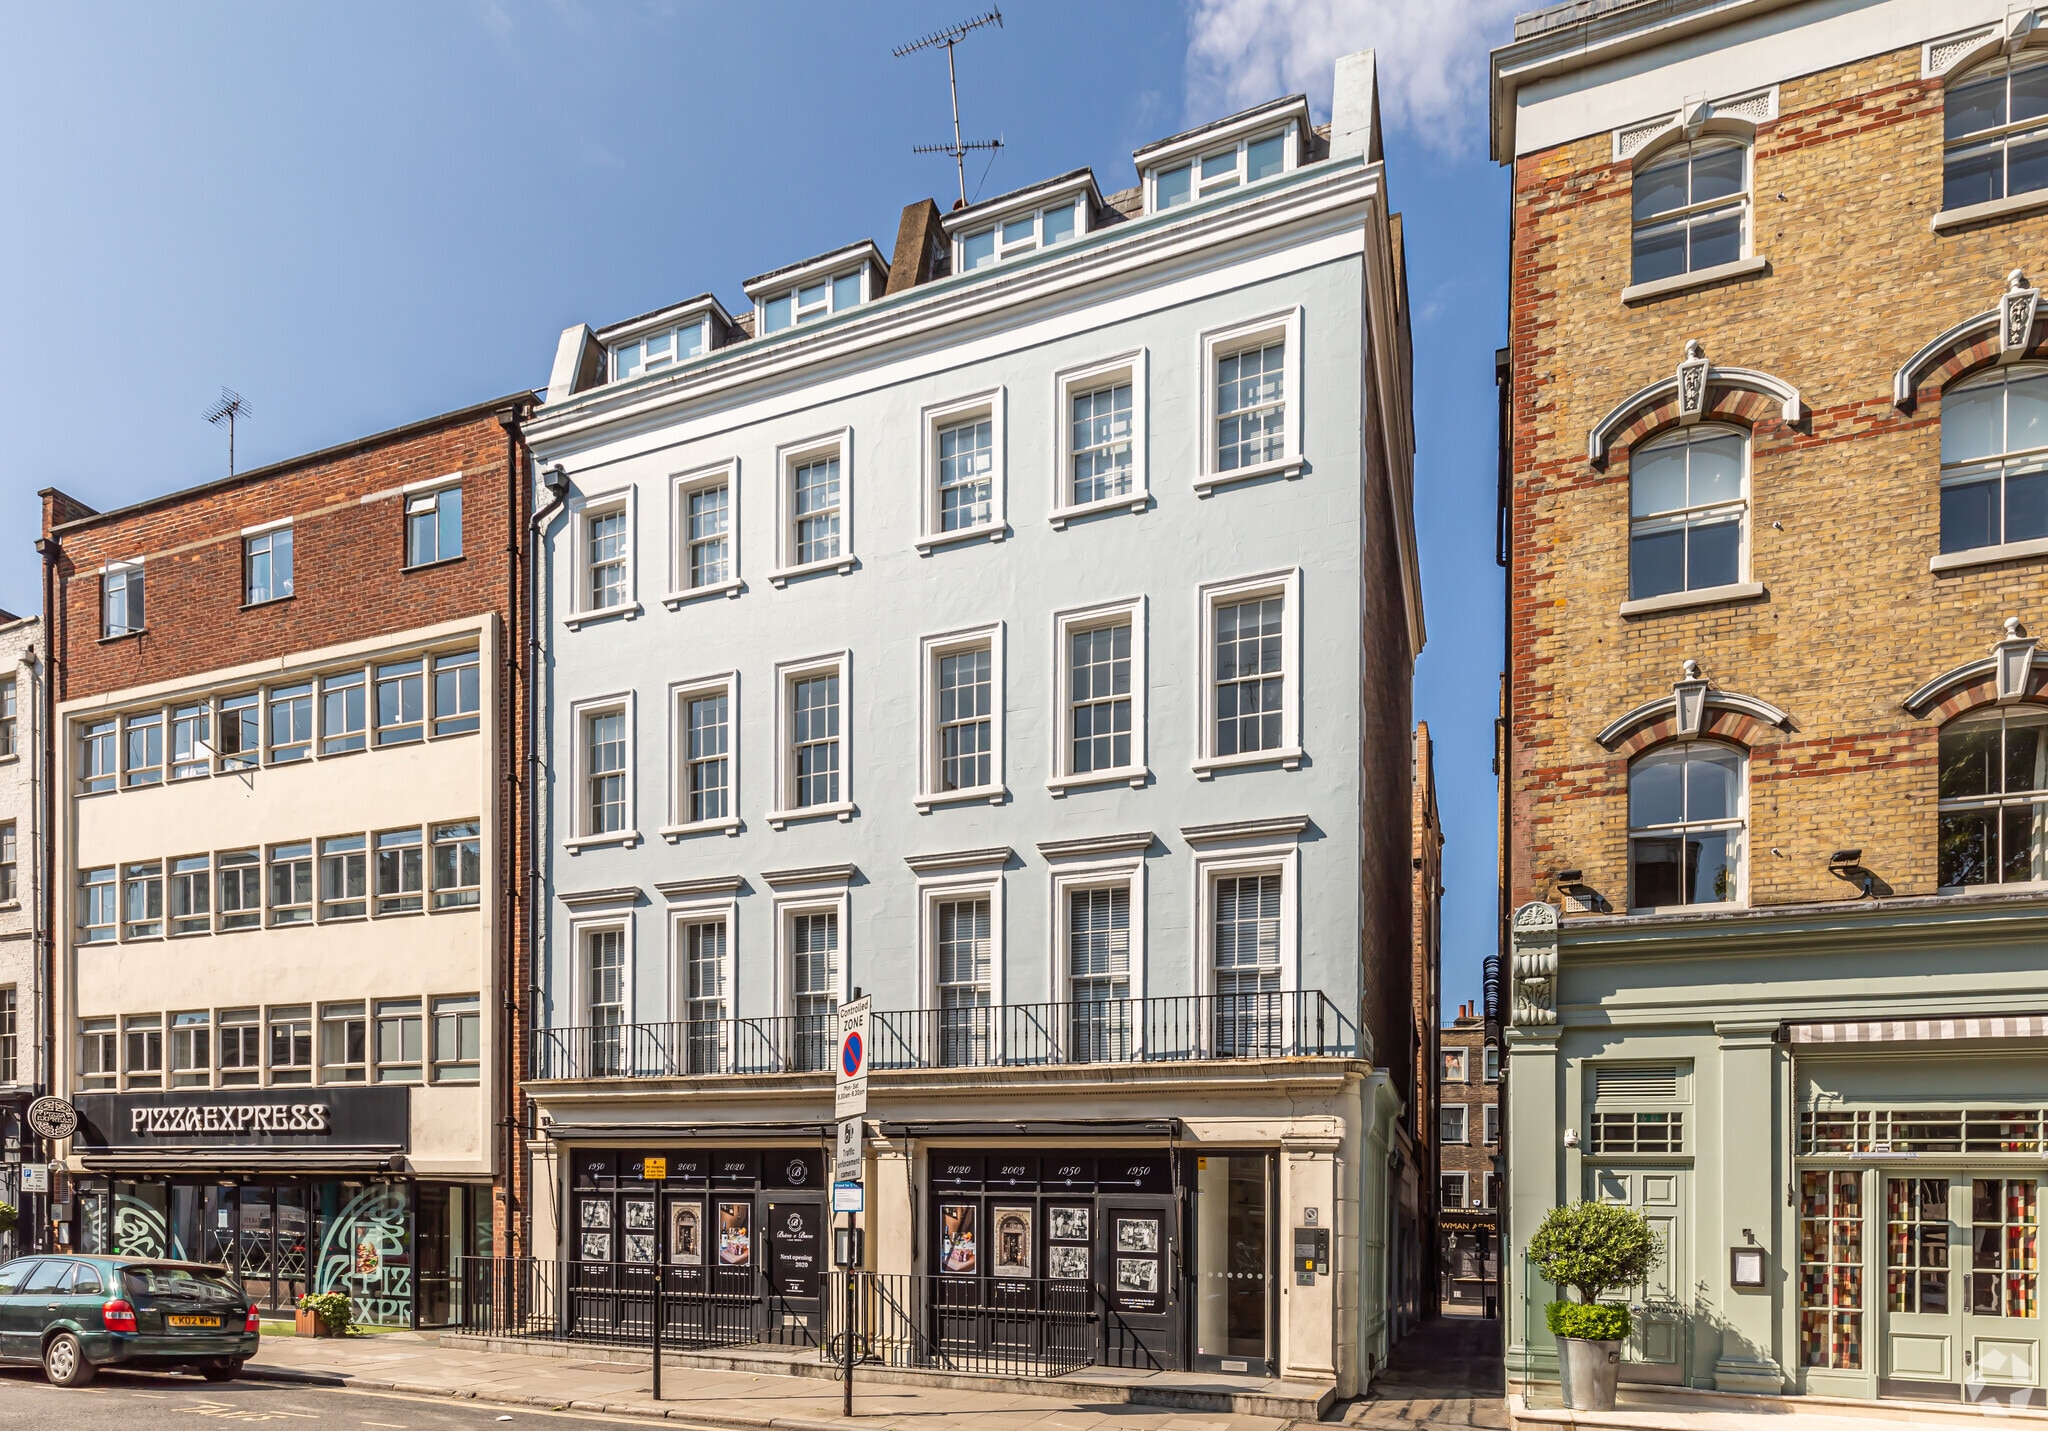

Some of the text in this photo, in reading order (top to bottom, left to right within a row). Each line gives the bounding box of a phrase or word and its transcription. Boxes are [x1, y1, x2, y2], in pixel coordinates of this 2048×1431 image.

[840, 1000, 868, 1018] Controlled
[844, 1015, 864, 1031] ZONE
[37, 1115, 73, 1124] EXPRESS
[43, 1111, 66, 1119] PIZZA
[843, 1148, 855, 1157] Traffic
[588, 1162, 605, 1171] 1950
[677, 1163, 696, 1171] 2003
[724, 1163, 745, 1171] 2020
[837, 1157, 860, 1168] enforcement
[841, 1169, 856, 1178] cameras
[947, 1165, 971, 1174] 2020
[1001, 1166, 1025, 1175] 2003
[1058, 1166, 1081, 1175] 1950
[1127, 1166, 1150, 1175] 1950
[792, 1254, 812, 1262] opening
[199, 1316, 217, 1325] WPN
